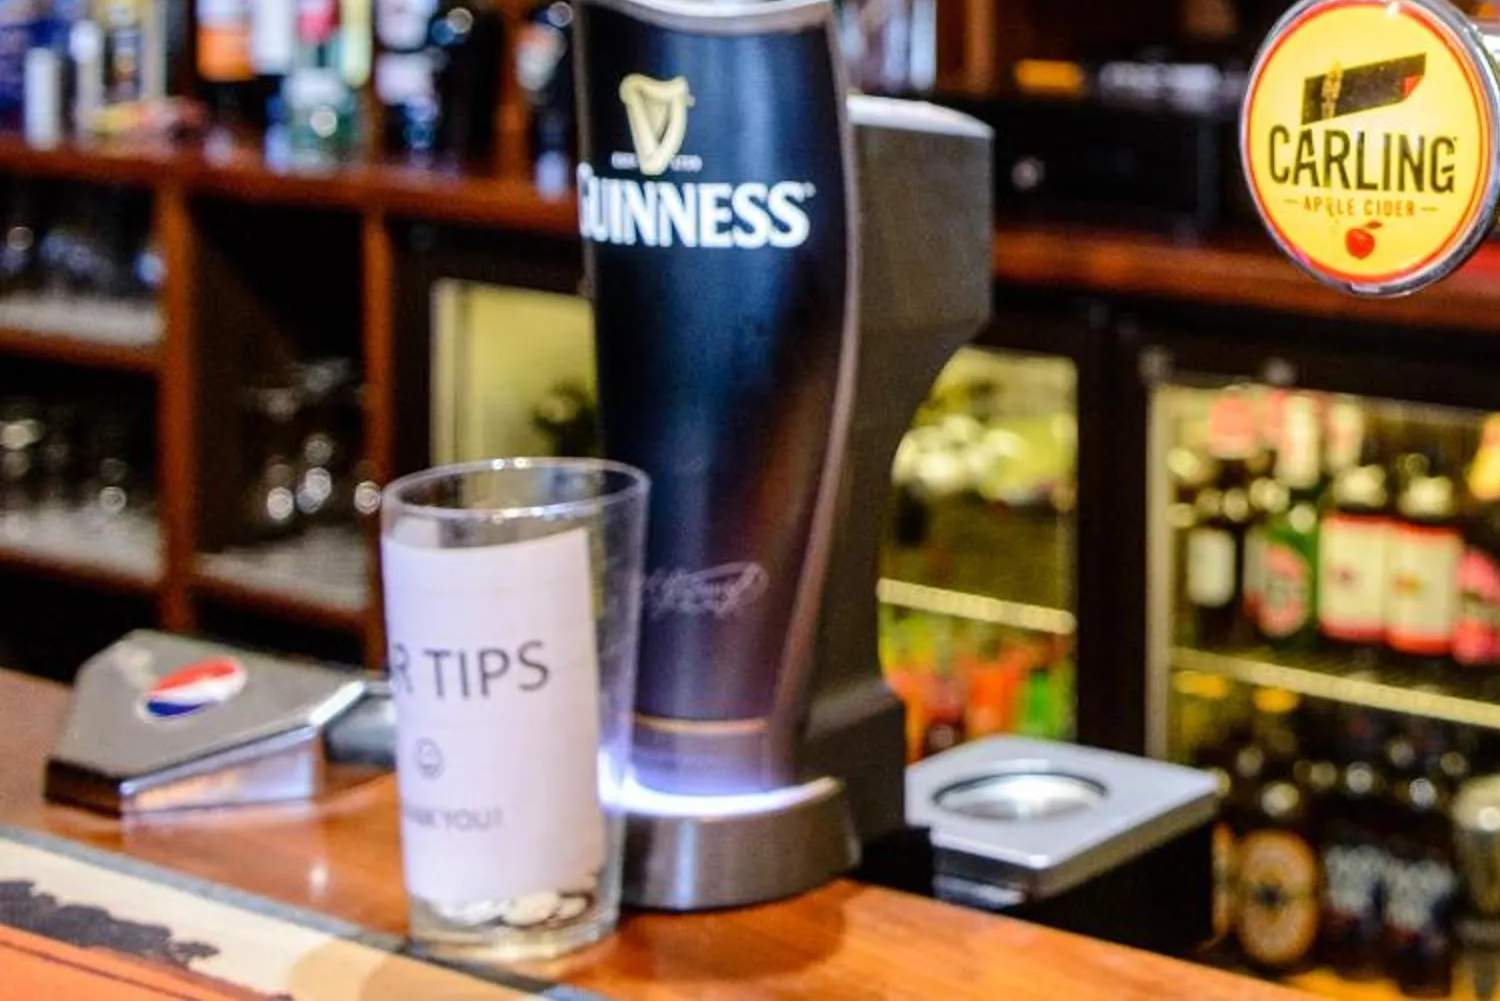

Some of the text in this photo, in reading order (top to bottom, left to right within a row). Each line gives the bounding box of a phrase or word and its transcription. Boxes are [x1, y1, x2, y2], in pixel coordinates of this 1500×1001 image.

[1268, 124, 1457, 194] CARLING
[1363, 199, 1416, 217] CIDER
[423, 639, 551, 698] TIPS
